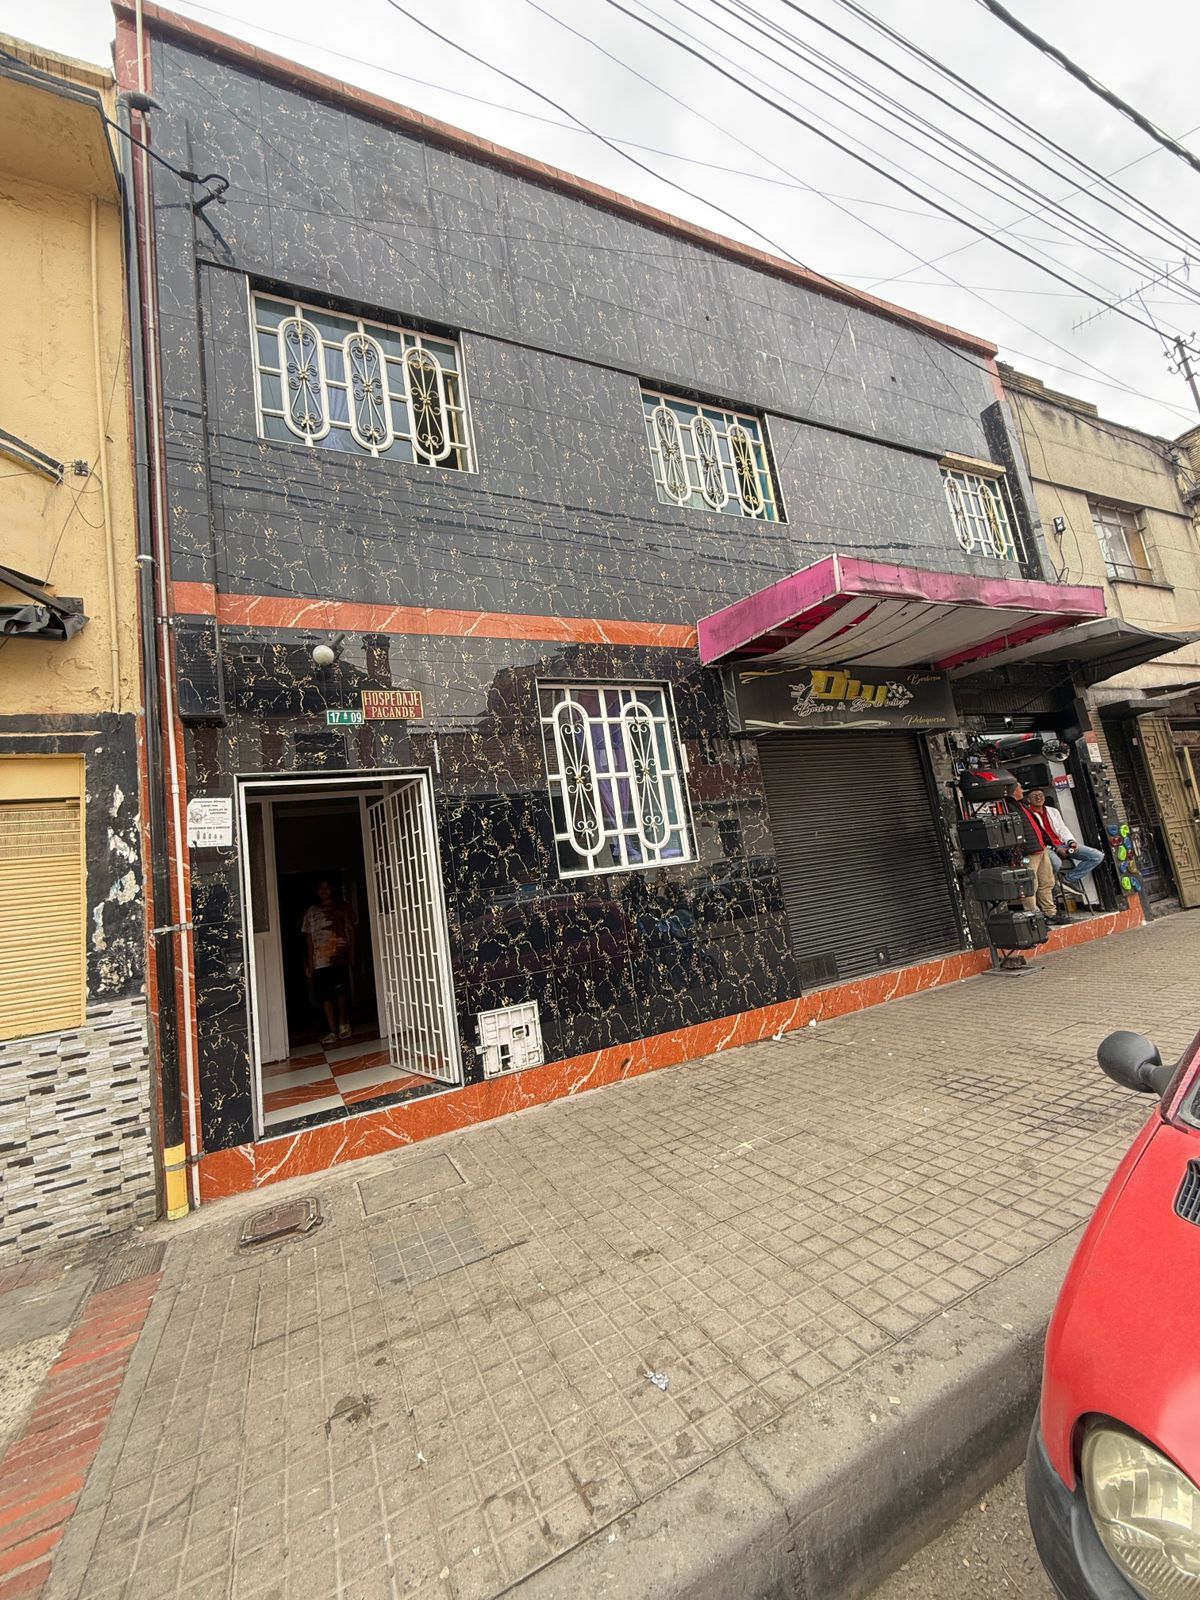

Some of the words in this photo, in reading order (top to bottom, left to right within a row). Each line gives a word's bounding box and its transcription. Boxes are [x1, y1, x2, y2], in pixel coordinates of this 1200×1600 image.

[364, 692, 420, 706] HOSPEDAJE
[330, 712, 340, 723] 17
[351, 712, 362, 723] 09
